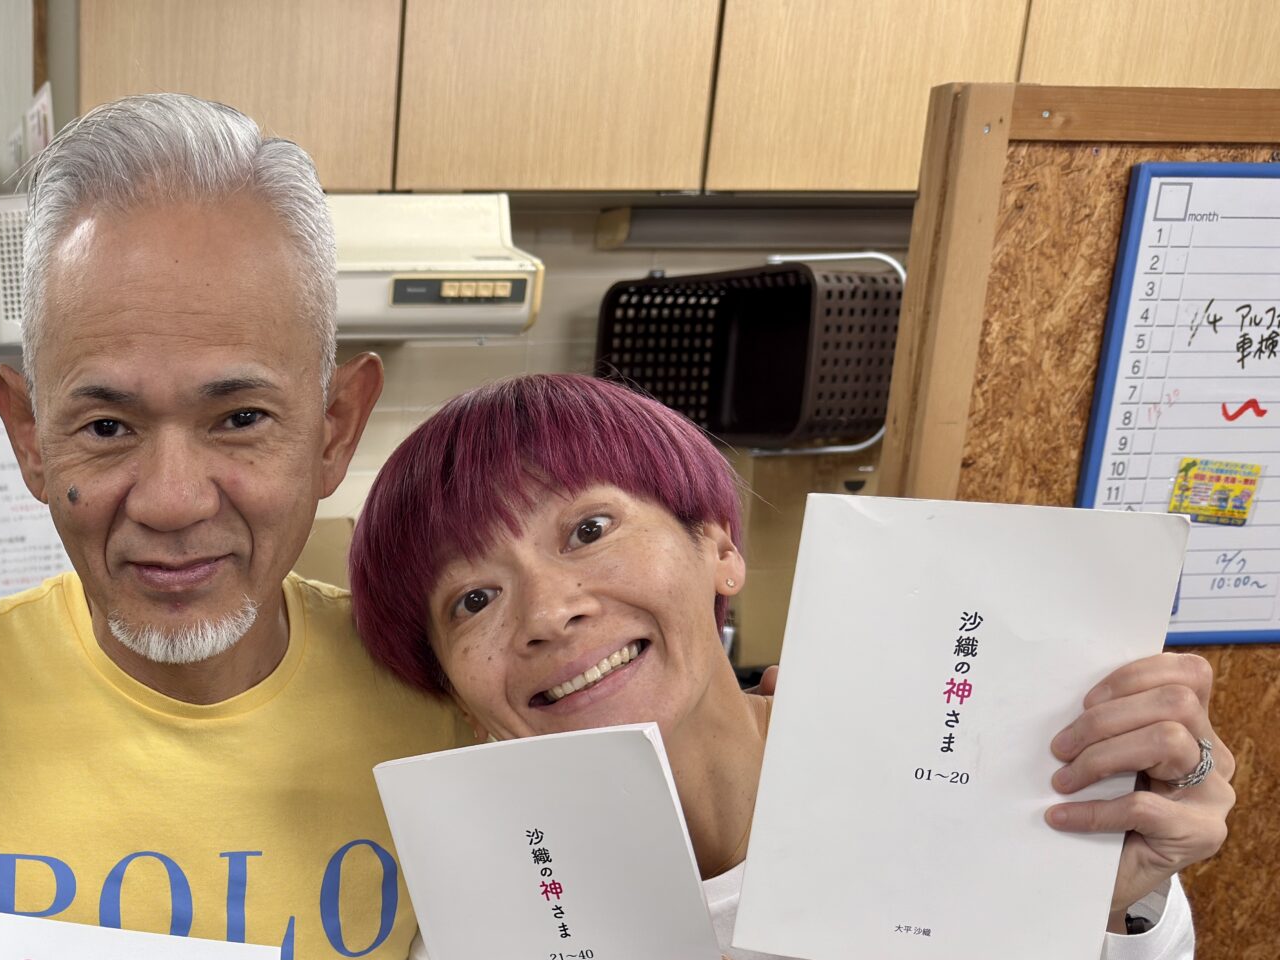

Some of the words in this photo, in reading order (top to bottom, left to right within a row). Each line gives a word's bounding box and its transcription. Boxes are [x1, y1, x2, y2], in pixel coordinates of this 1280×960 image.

[1187, 212, 1219, 222] month
[1157, 228, 1163, 243] 1
[1150, 255, 1160, 270] 2
[1145, 281, 1155, 297] 3
[1140, 308, 1149, 323] 4
[1235, 304, 1280, 332] アルフ
[1136, 334, 1145, 349] 5
[1236, 330, 1280, 370] 車検
[1131, 360, 1141, 375] 6
[1128, 385, 1137, 400] 7
[1122, 410, 1132, 426] 8
[1118, 436, 1128, 451] 9
[1112, 461, 1125, 476] 10
[1107, 486, 1120, 501] 11
[940, 611, 984, 753] 沙織の神さま
[525, 828, 572, 939] 沙織の神さま
